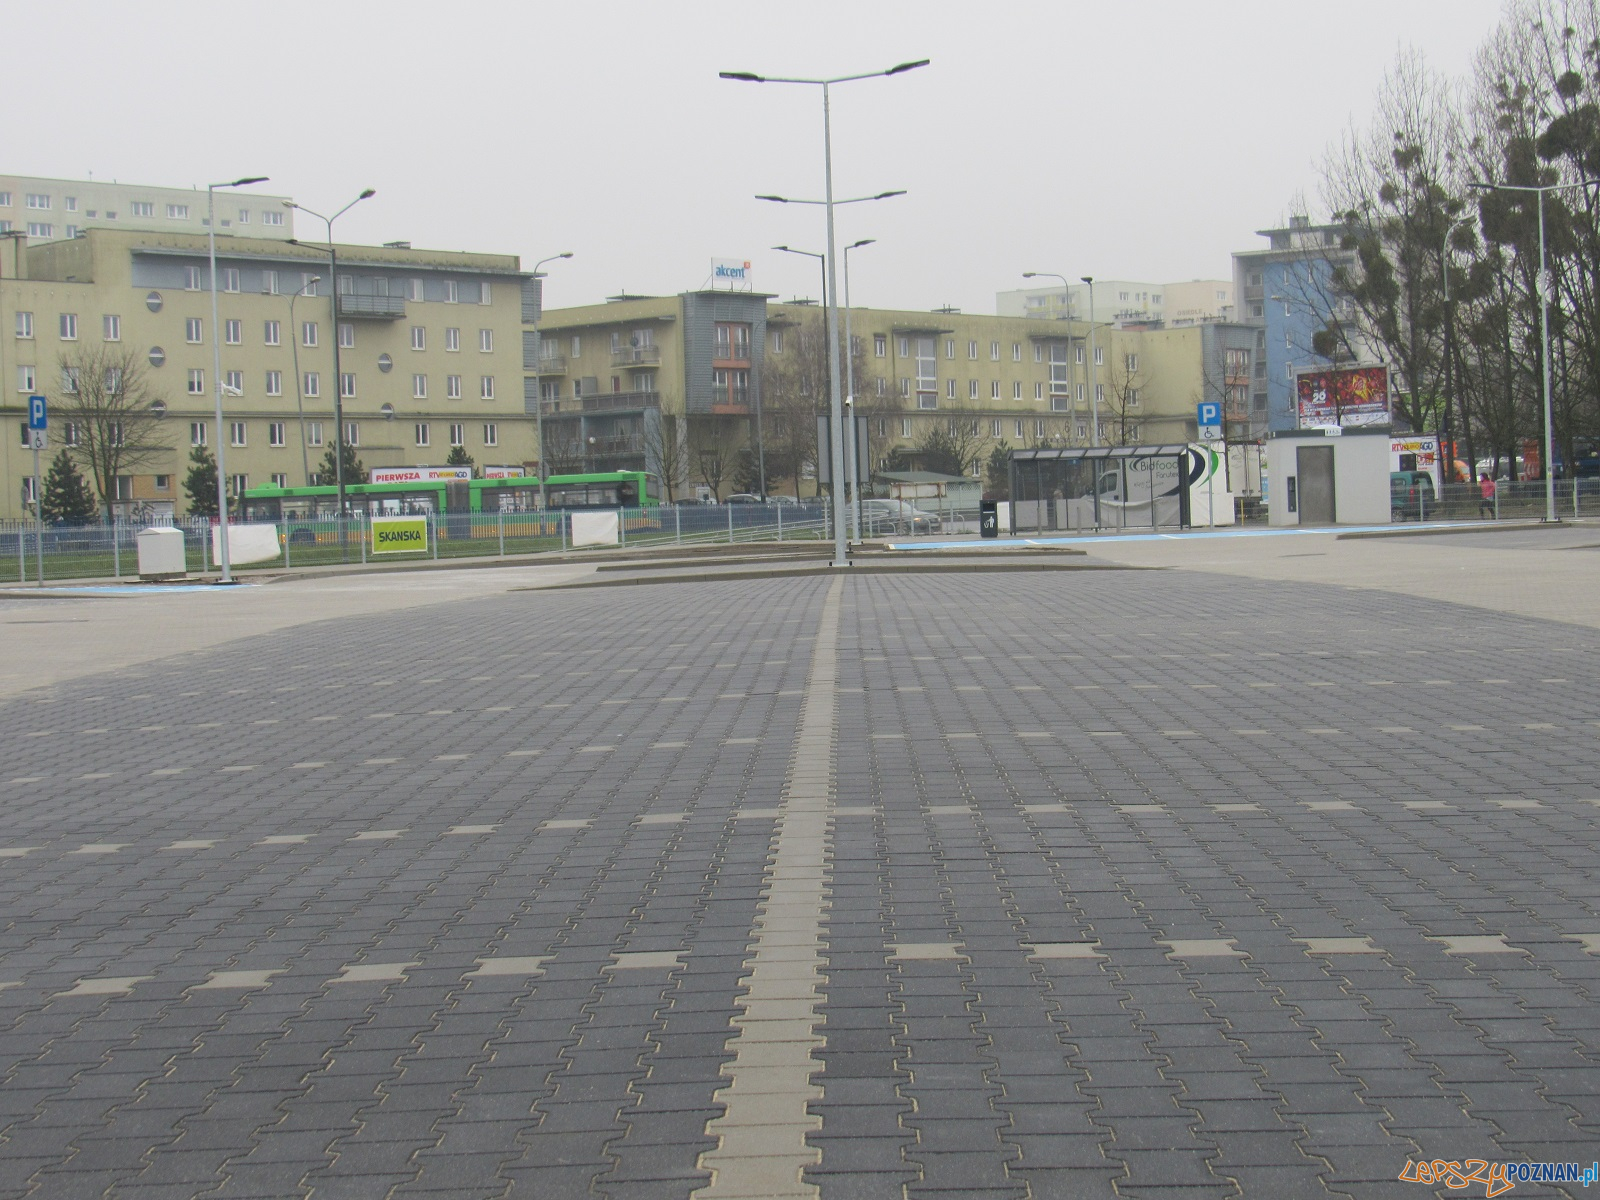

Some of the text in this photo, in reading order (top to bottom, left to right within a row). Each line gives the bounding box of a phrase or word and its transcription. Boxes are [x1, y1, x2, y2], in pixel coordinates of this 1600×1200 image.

[715, 264, 745, 278] akcent
[33, 400, 43, 425] P
[1203, 405, 1215, 423] P
[376, 472, 420, 482] PIERWSZA
[379, 530, 421, 542] SKANSKA
